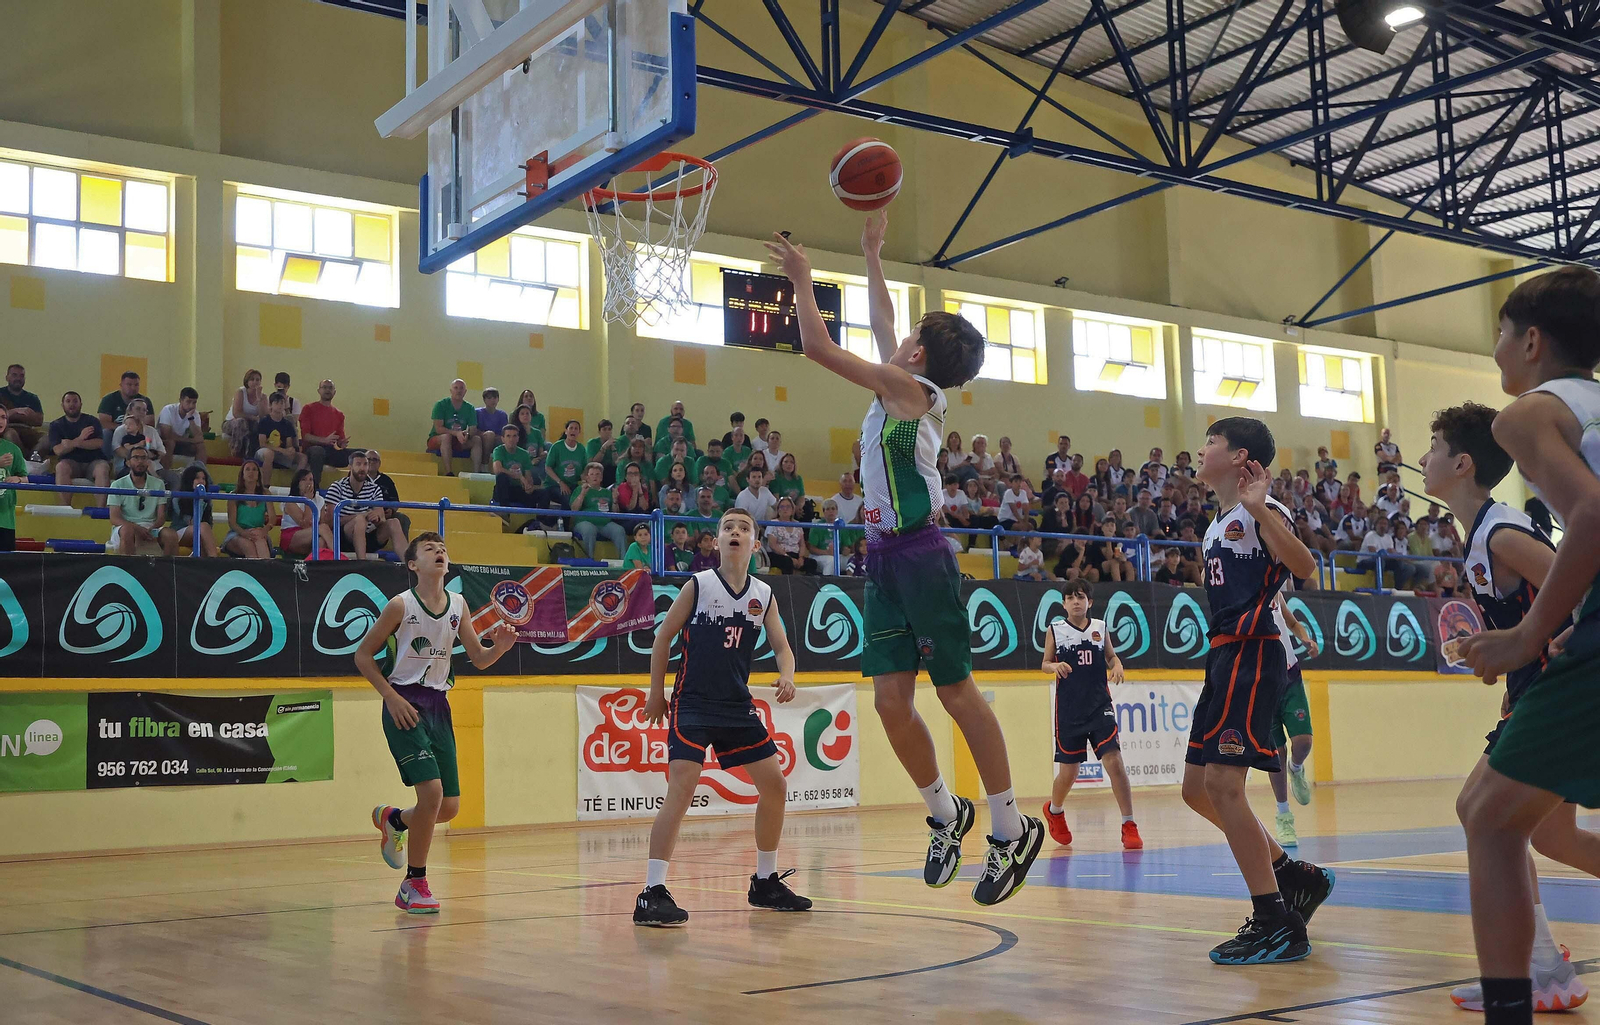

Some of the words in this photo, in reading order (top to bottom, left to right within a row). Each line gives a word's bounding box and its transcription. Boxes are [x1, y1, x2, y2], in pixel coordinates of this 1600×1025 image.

[480, 566, 489, 574] EBG
[580, 569, 590, 577] EBG
[1207, 557, 1225, 587] 33
[496, 582, 527, 598] EBG
[596, 582, 625, 596] EBG
[723, 626, 743, 649] 34
[1077, 649, 1093, 666] 30
[1115, 691, 1195, 733] mite
[98, 718, 122, 738] tu
[128, 716, 181, 738] fibra
[187, 721, 214, 738] en
[219, 722, 269, 738] casa
[589, 732, 631, 764] de
[1122, 740, 1161, 750] entos
[97, 761, 126, 777] 956
[129, 760, 157, 775] 762
[161, 759, 189, 775] 034
[1078, 766, 1101, 776] SKF
[1126, 766, 1141, 776] 956
[1143, 765, 1159, 775] 020
[1161, 764, 1176, 774] 666
[804, 790, 819, 801] 652
[820, 789, 830, 799] 95
[832, 788, 842, 798] 58
[844, 787, 854, 797] 24
[583, 795, 603, 811] TÉ
[607, 798, 616, 811] E
